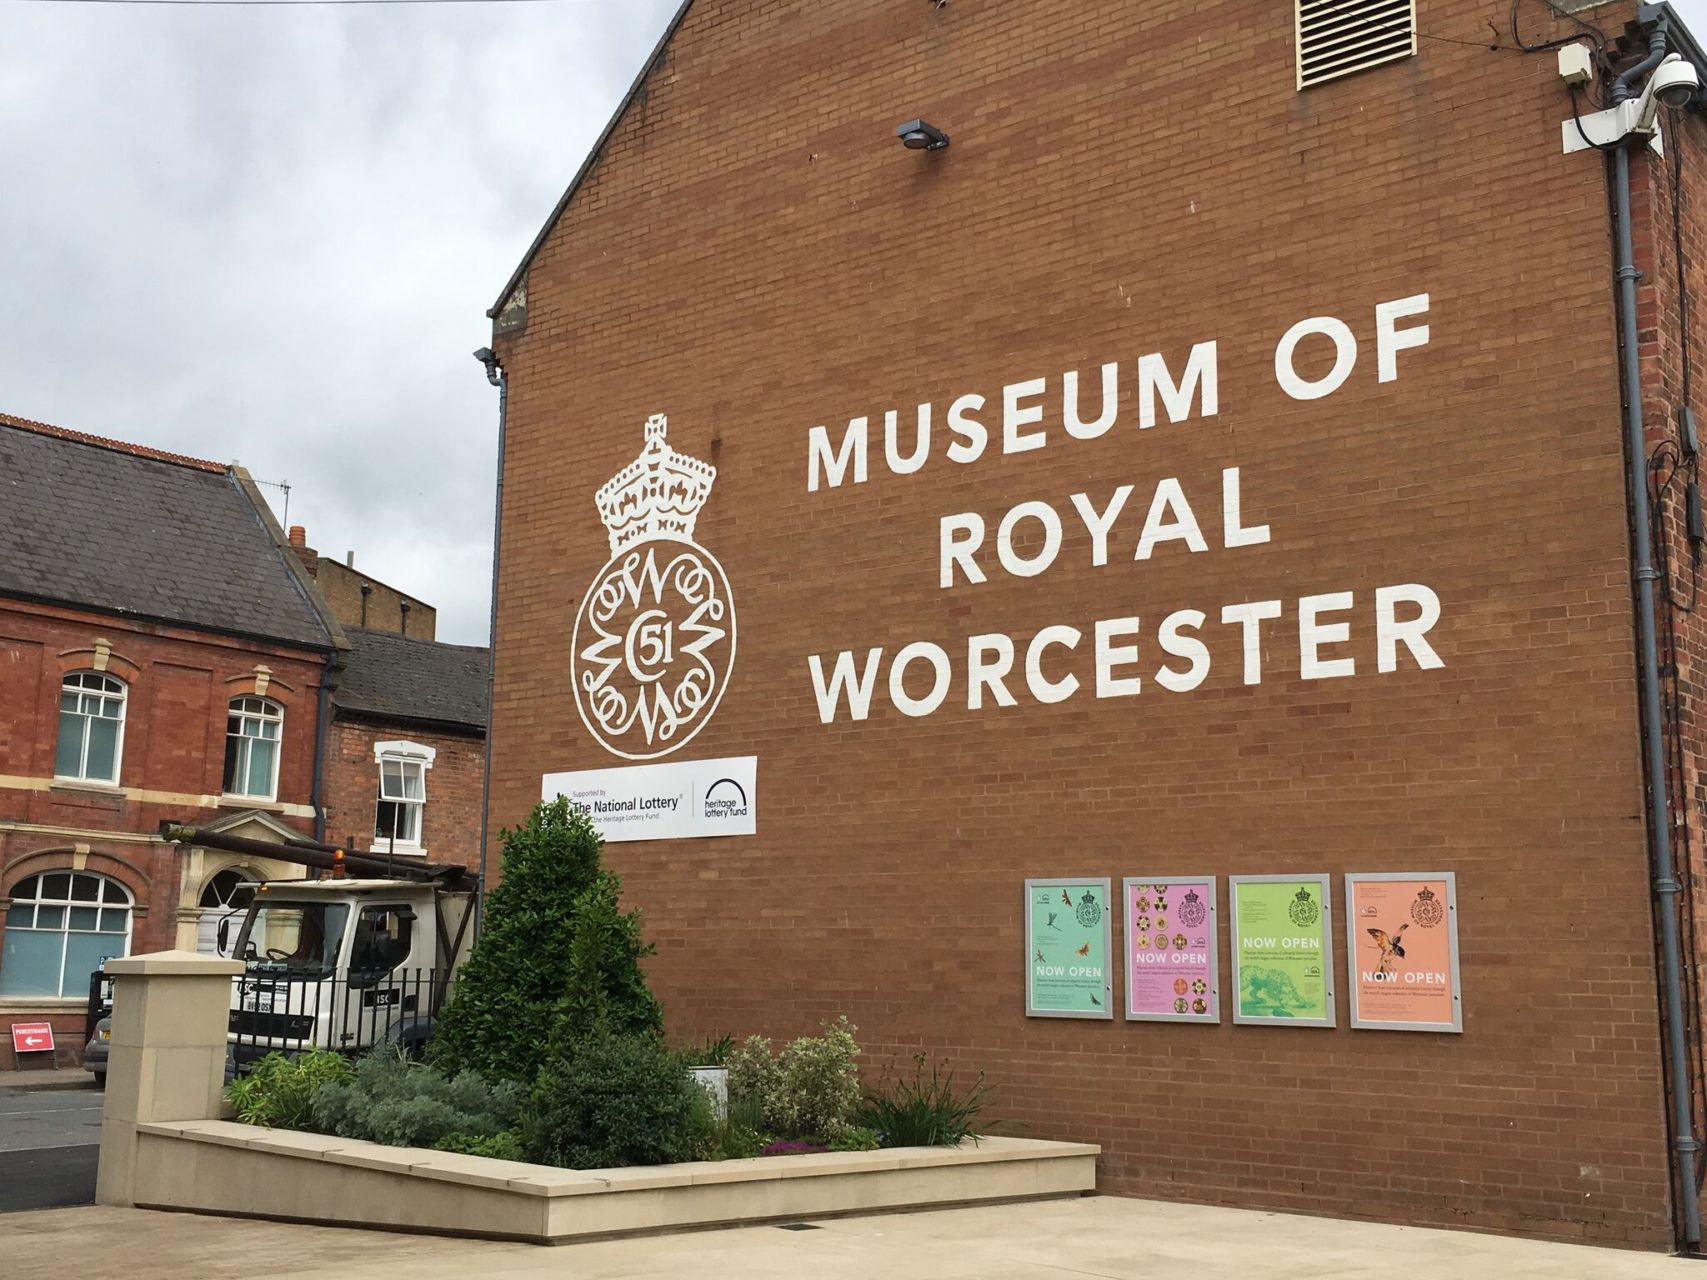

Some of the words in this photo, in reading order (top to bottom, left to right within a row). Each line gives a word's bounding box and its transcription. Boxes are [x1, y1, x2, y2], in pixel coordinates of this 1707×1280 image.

[807, 340, 1219, 492] MUSEUM
[1275, 293, 1430, 400] OF
[940, 467, 1271, 588] ROYAL
[807, 583, 1446, 723] WORCESTER
[572, 790, 599, 798] Supported
[600, 789, 606, 797] by
[573, 800, 591, 814] The
[594, 797, 636, 813] National
[704, 798, 737, 810] heritage
[603, 814, 625, 824] Heritage
[626, 813, 645, 822] Lottery
[646, 812, 660, 820] Fund
[704, 807, 728, 818] lottery
[730, 807, 747, 817] fund
[1243, 937, 1277, 948] NOW
[1281, 937, 1319, 948] OPEN
[1137, 953, 1167, 963] NOW
[1171, 953, 1206, 963] OPEN
[1037, 966, 1065, 976] NOW
[1069, 966, 1102, 977] OPEN
[1362, 971, 1398, 982] NOW
[1404, 972, 1446, 984] OPEN
